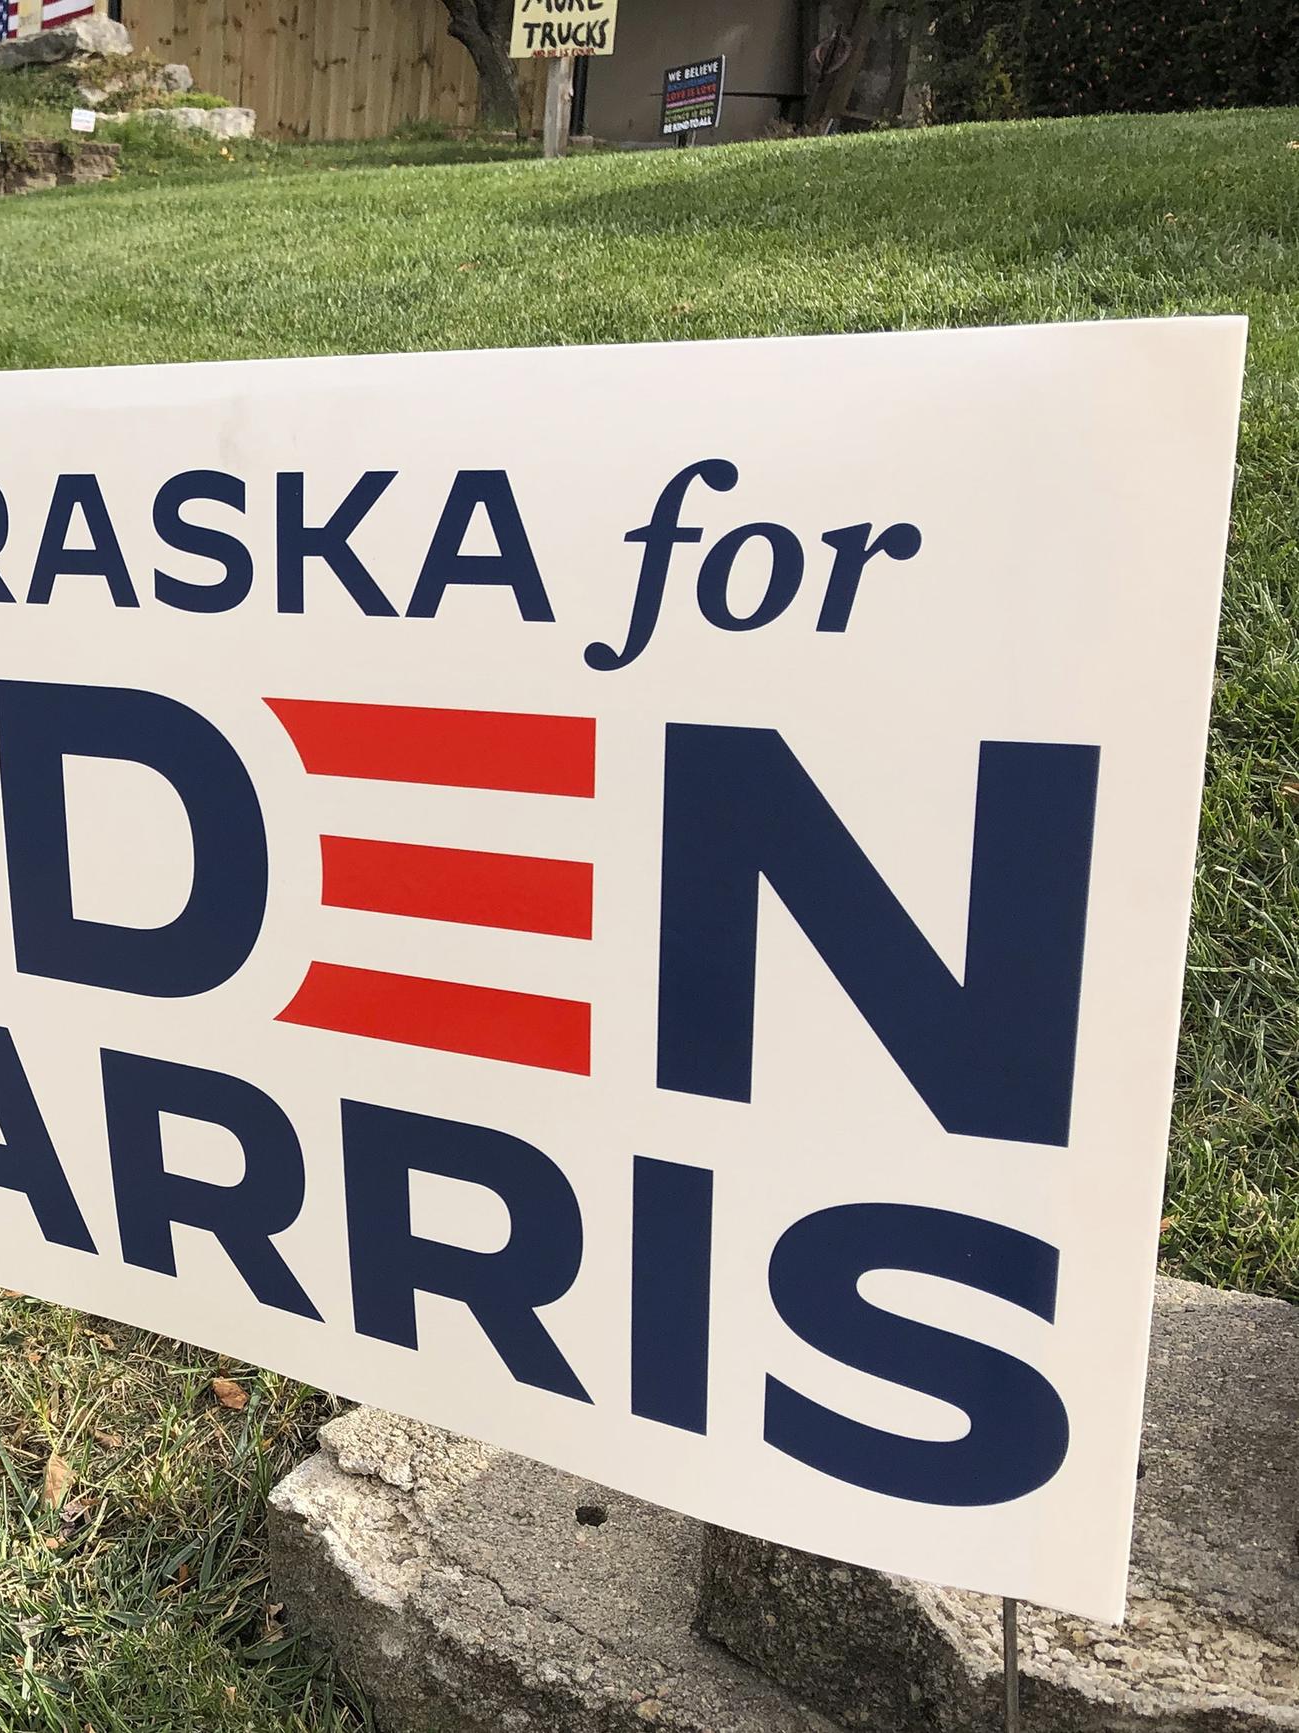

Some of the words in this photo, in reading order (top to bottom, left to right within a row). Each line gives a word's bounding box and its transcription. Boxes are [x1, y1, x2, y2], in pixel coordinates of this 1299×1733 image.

[523, 18, 610, 49] TRUCKS
[668, 70, 682, 82] WE
[684, 61, 719, 79] BELIEVE
[584, 459, 922, 672] for
